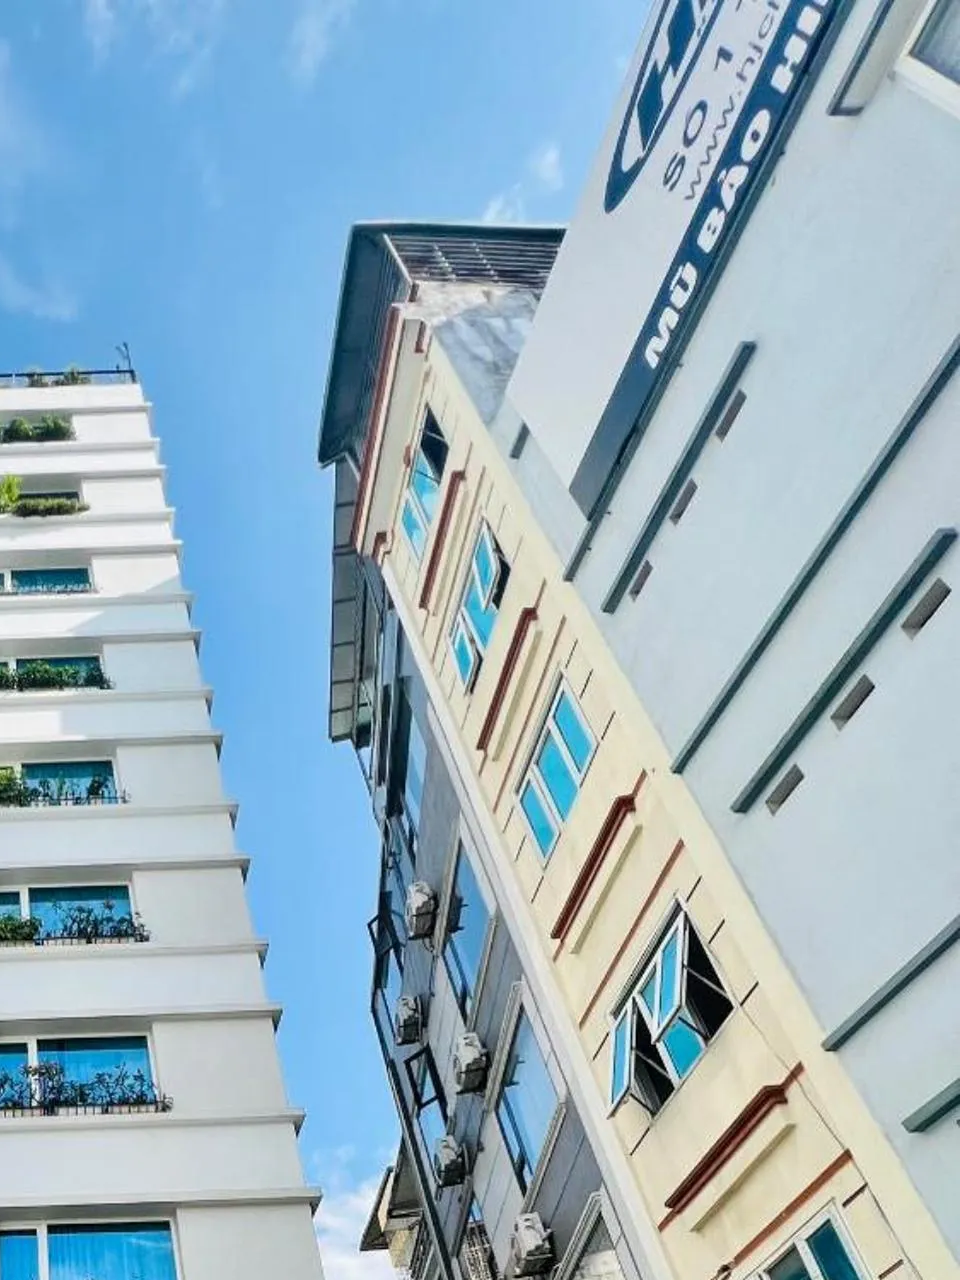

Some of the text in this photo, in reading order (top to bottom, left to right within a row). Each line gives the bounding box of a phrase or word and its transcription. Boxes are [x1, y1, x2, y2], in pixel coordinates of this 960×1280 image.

[714, 45, 734, 71] 1
[644, 0, 827, 369] MŨ BẢO HI
